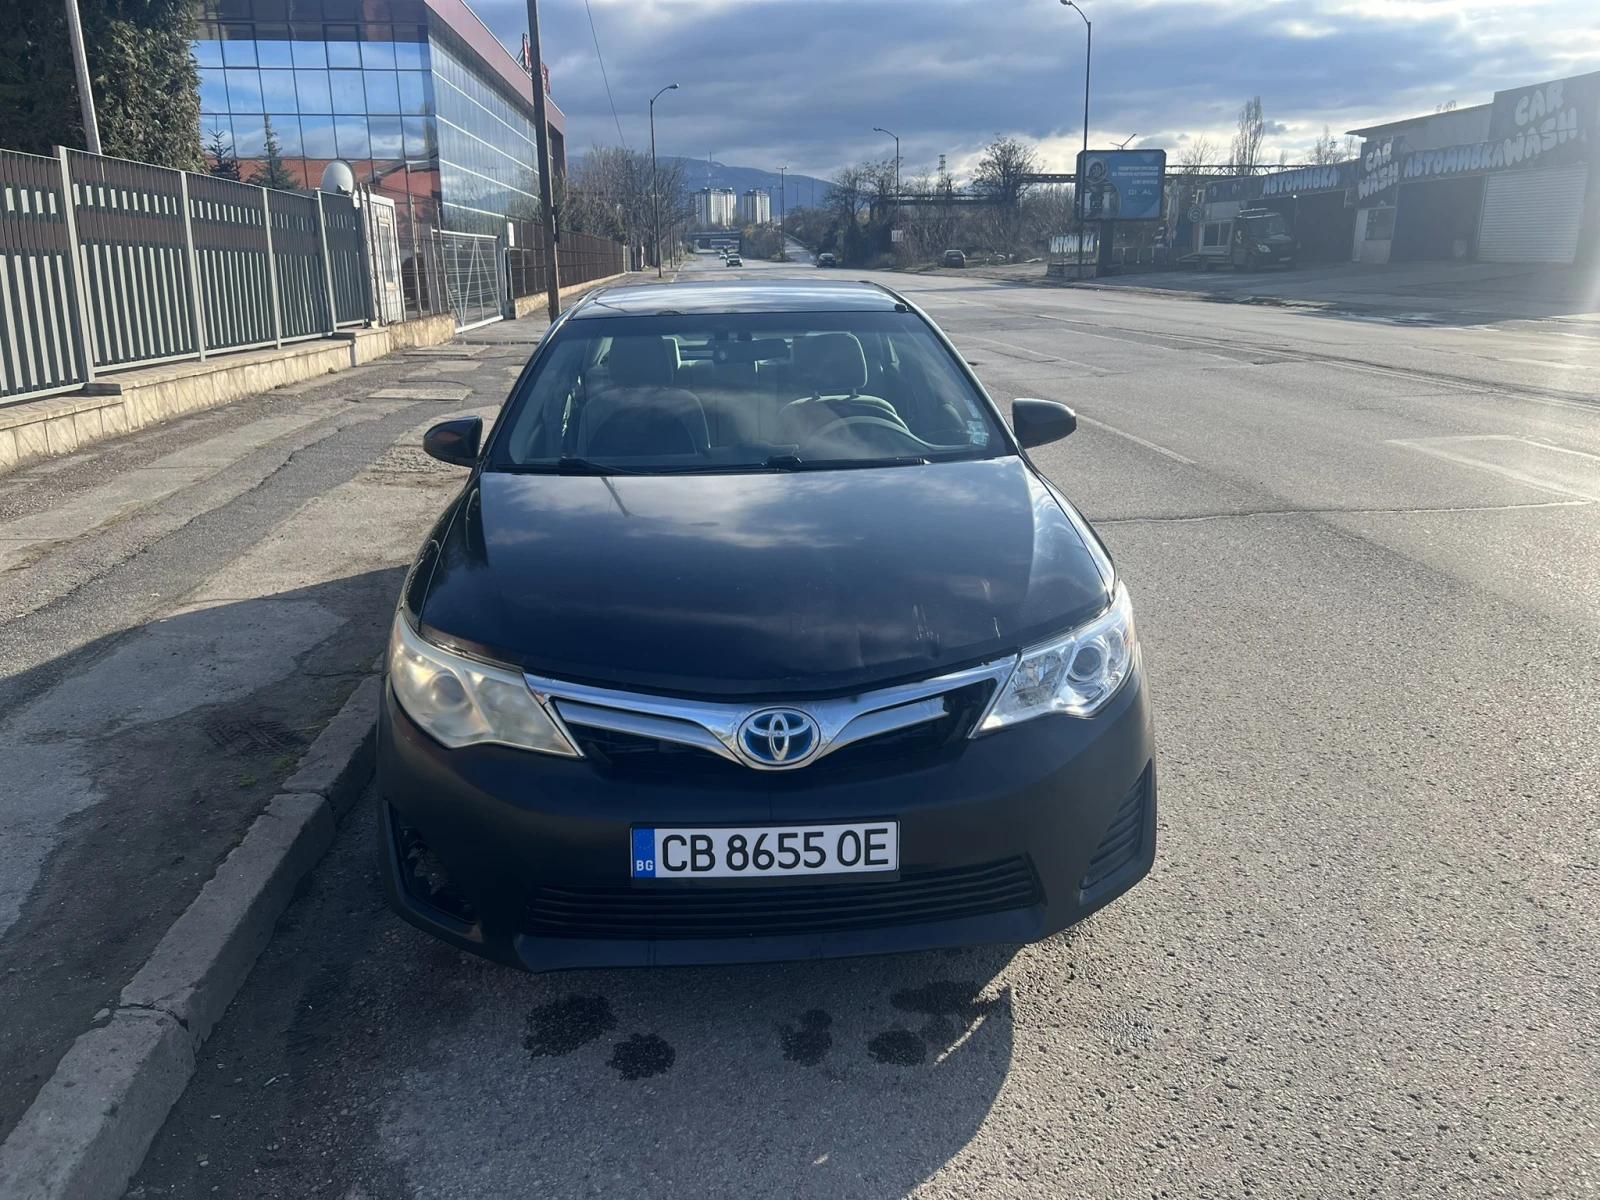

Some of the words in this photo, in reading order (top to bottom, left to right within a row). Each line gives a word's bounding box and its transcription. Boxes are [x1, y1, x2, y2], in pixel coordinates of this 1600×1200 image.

[1515, 80, 1564, 126] CAR
[1503, 107, 1577, 167] WASH
[1365, 142, 1392, 172] CAR
[1404, 143, 1503, 178] АВТОМИВКА
[1262, 166, 1338, 195] АВТОМИВКА
[1358, 161, 1399, 199] WASH
[1050, 234, 1094, 253] АВТОМИКА
[636, 860, 654, 871] BG
[662, 834, 716, 871] CB
[726, 831, 827, 870] 8655
[837, 828, 889, 866] OE
